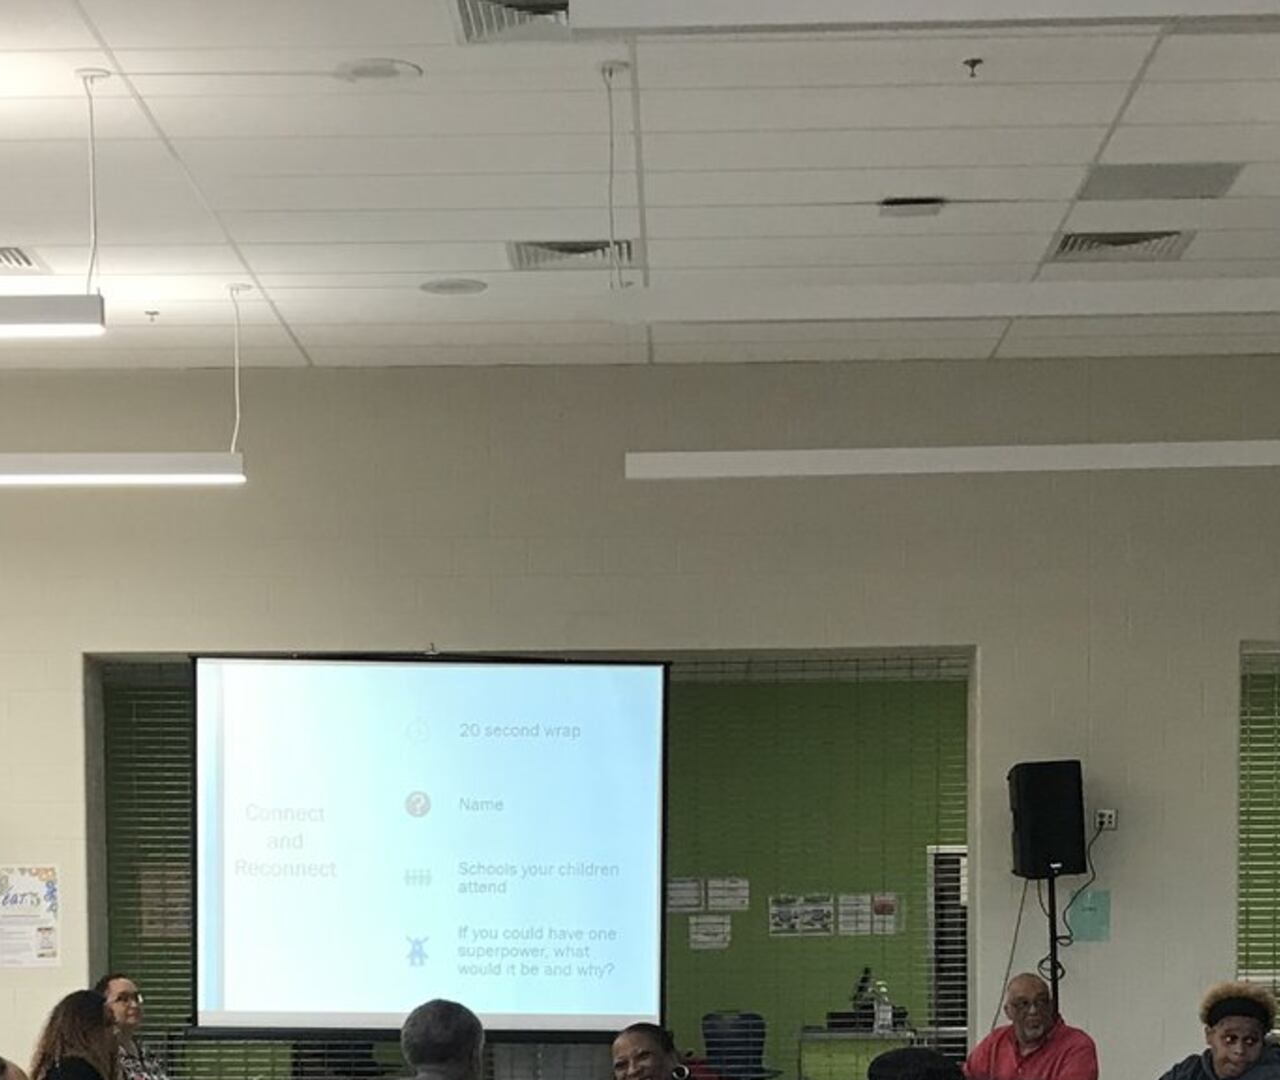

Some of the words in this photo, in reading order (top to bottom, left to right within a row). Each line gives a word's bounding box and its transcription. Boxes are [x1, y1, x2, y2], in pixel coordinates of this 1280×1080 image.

[458, 723, 481, 738] 20
[484, 723, 540, 738] second
[544, 725, 582, 741] wrap
[245, 803, 326, 823] Connect
[459, 797, 505, 812] Name
[266, 833, 304, 850] and
[234, 859, 338, 878] Reconnect
[457, 861, 519, 877] Schools
[521, 864, 556, 880] your
[558, 862, 620, 878] children
[457, 880, 508, 895] attend
[458, 925, 470, 940] If
[472, 928, 498, 943] you
[502, 926, 544, 941] could
[548, 927, 584, 942] have
[588, 928, 618, 942] one
[457, 945, 550, 959] superpower,
[553, 944, 591, 959] what
[457, 962, 502, 977] would
[506, 963, 517, 977] it
[520, 962, 540, 977] be
[543, 963, 573, 978] and
[576, 962, 616, 980] why?
